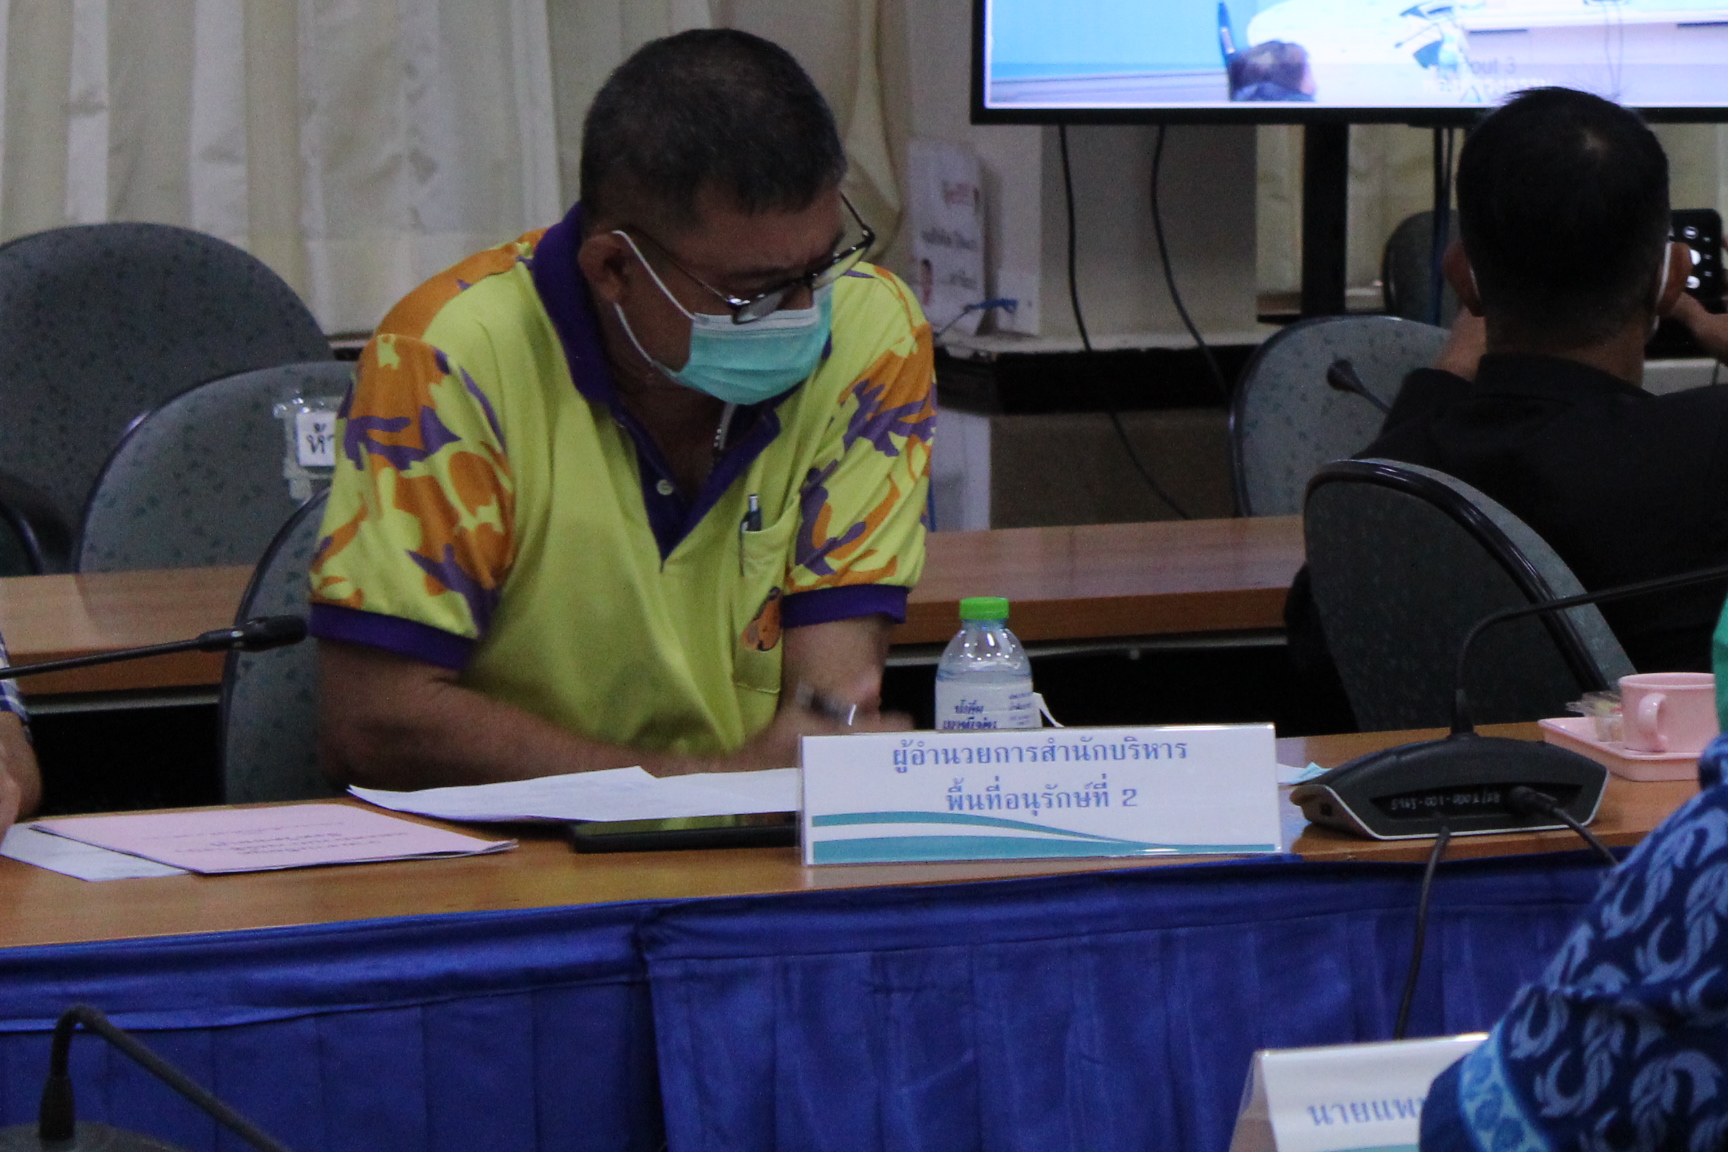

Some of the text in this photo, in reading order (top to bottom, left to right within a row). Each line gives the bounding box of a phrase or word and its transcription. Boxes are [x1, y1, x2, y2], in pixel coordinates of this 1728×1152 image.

[892, 736, 1188, 774] ผู้อำนวยการสำนักบริหาร
[945, 773, 1138, 817] พื้นที่อนุรักษ์ที่ 2
[1307, 1097, 1427, 1125] นายแพ
